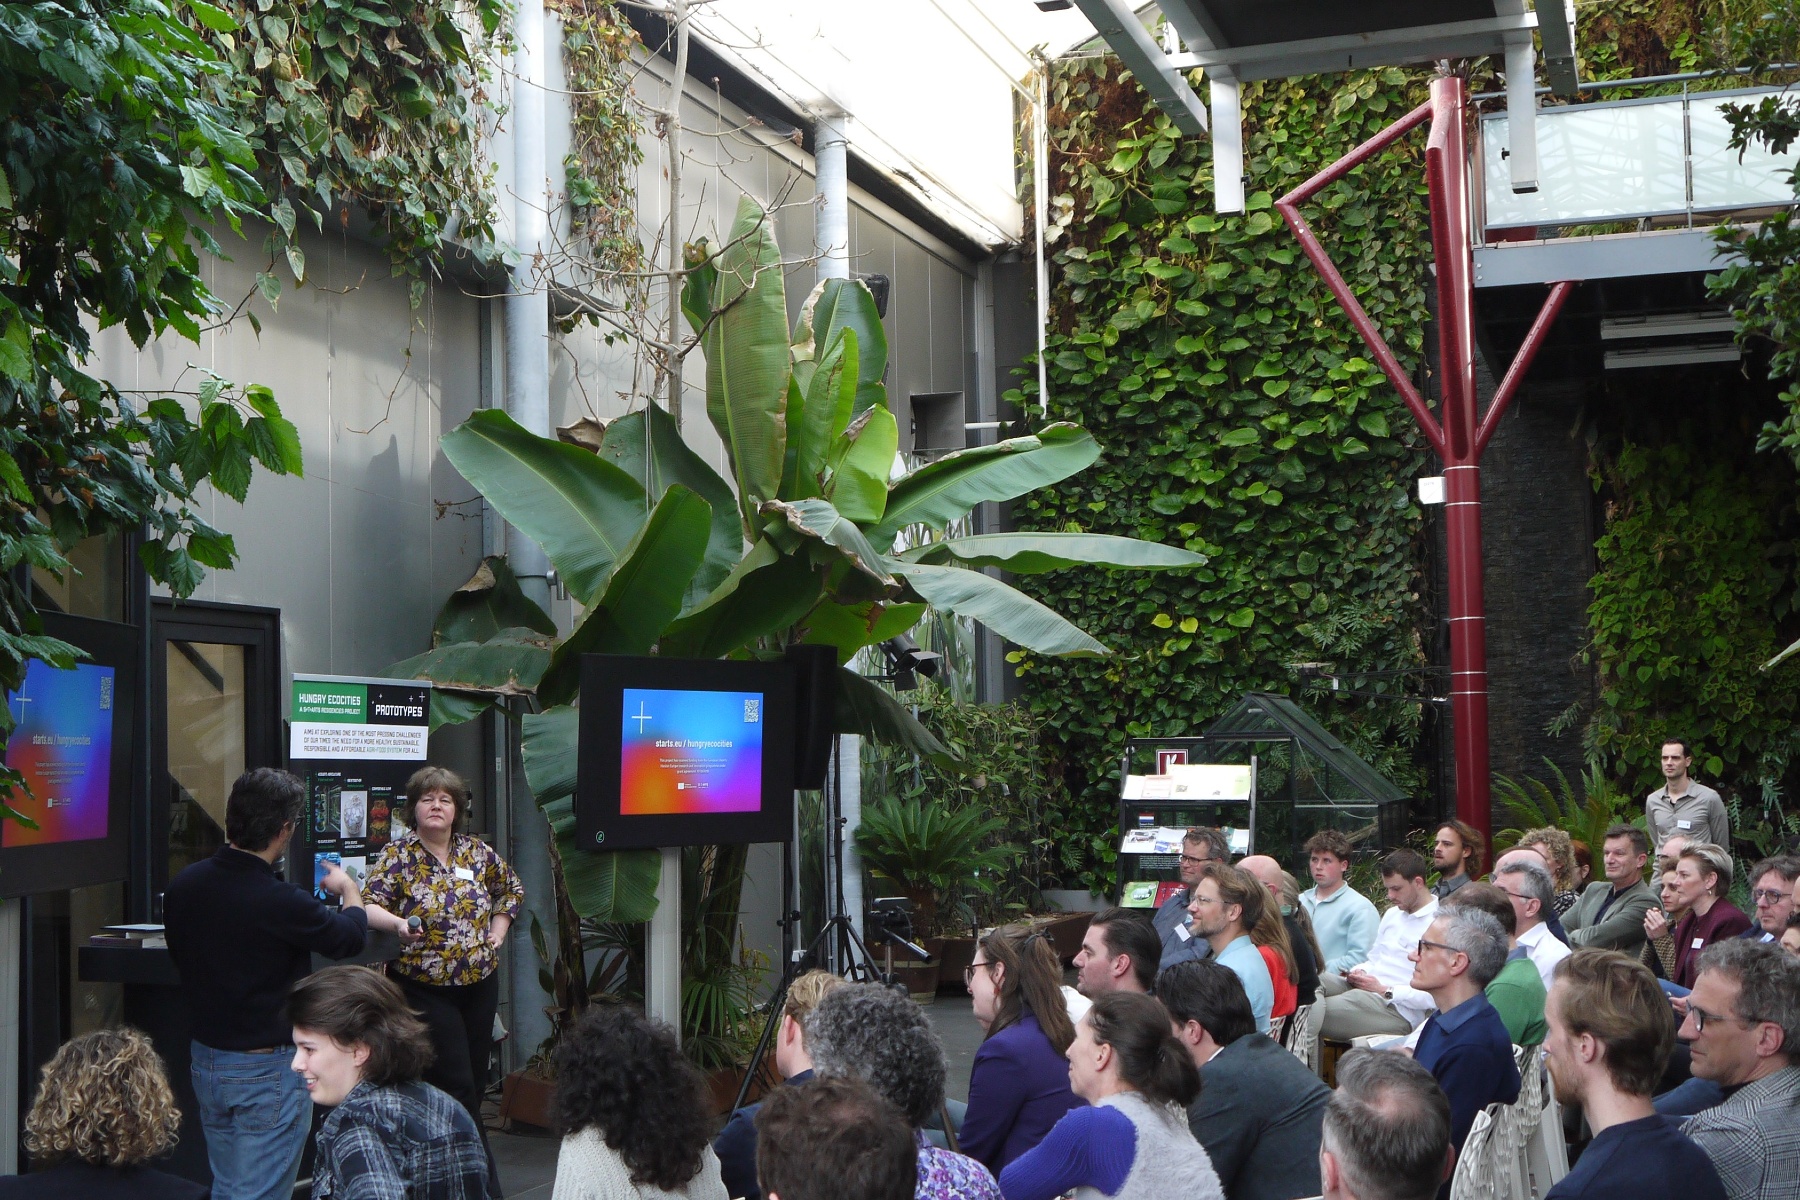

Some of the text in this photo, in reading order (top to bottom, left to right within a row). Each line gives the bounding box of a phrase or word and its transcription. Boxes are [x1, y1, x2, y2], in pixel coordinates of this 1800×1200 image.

[299, 693, 360, 706] HUNGRY ECOCITIES
[376, 704, 422, 717] PROTOTYPES
[656, 740, 682, 748] starts.eu
[688, 740, 732, 749] hungryecocities
